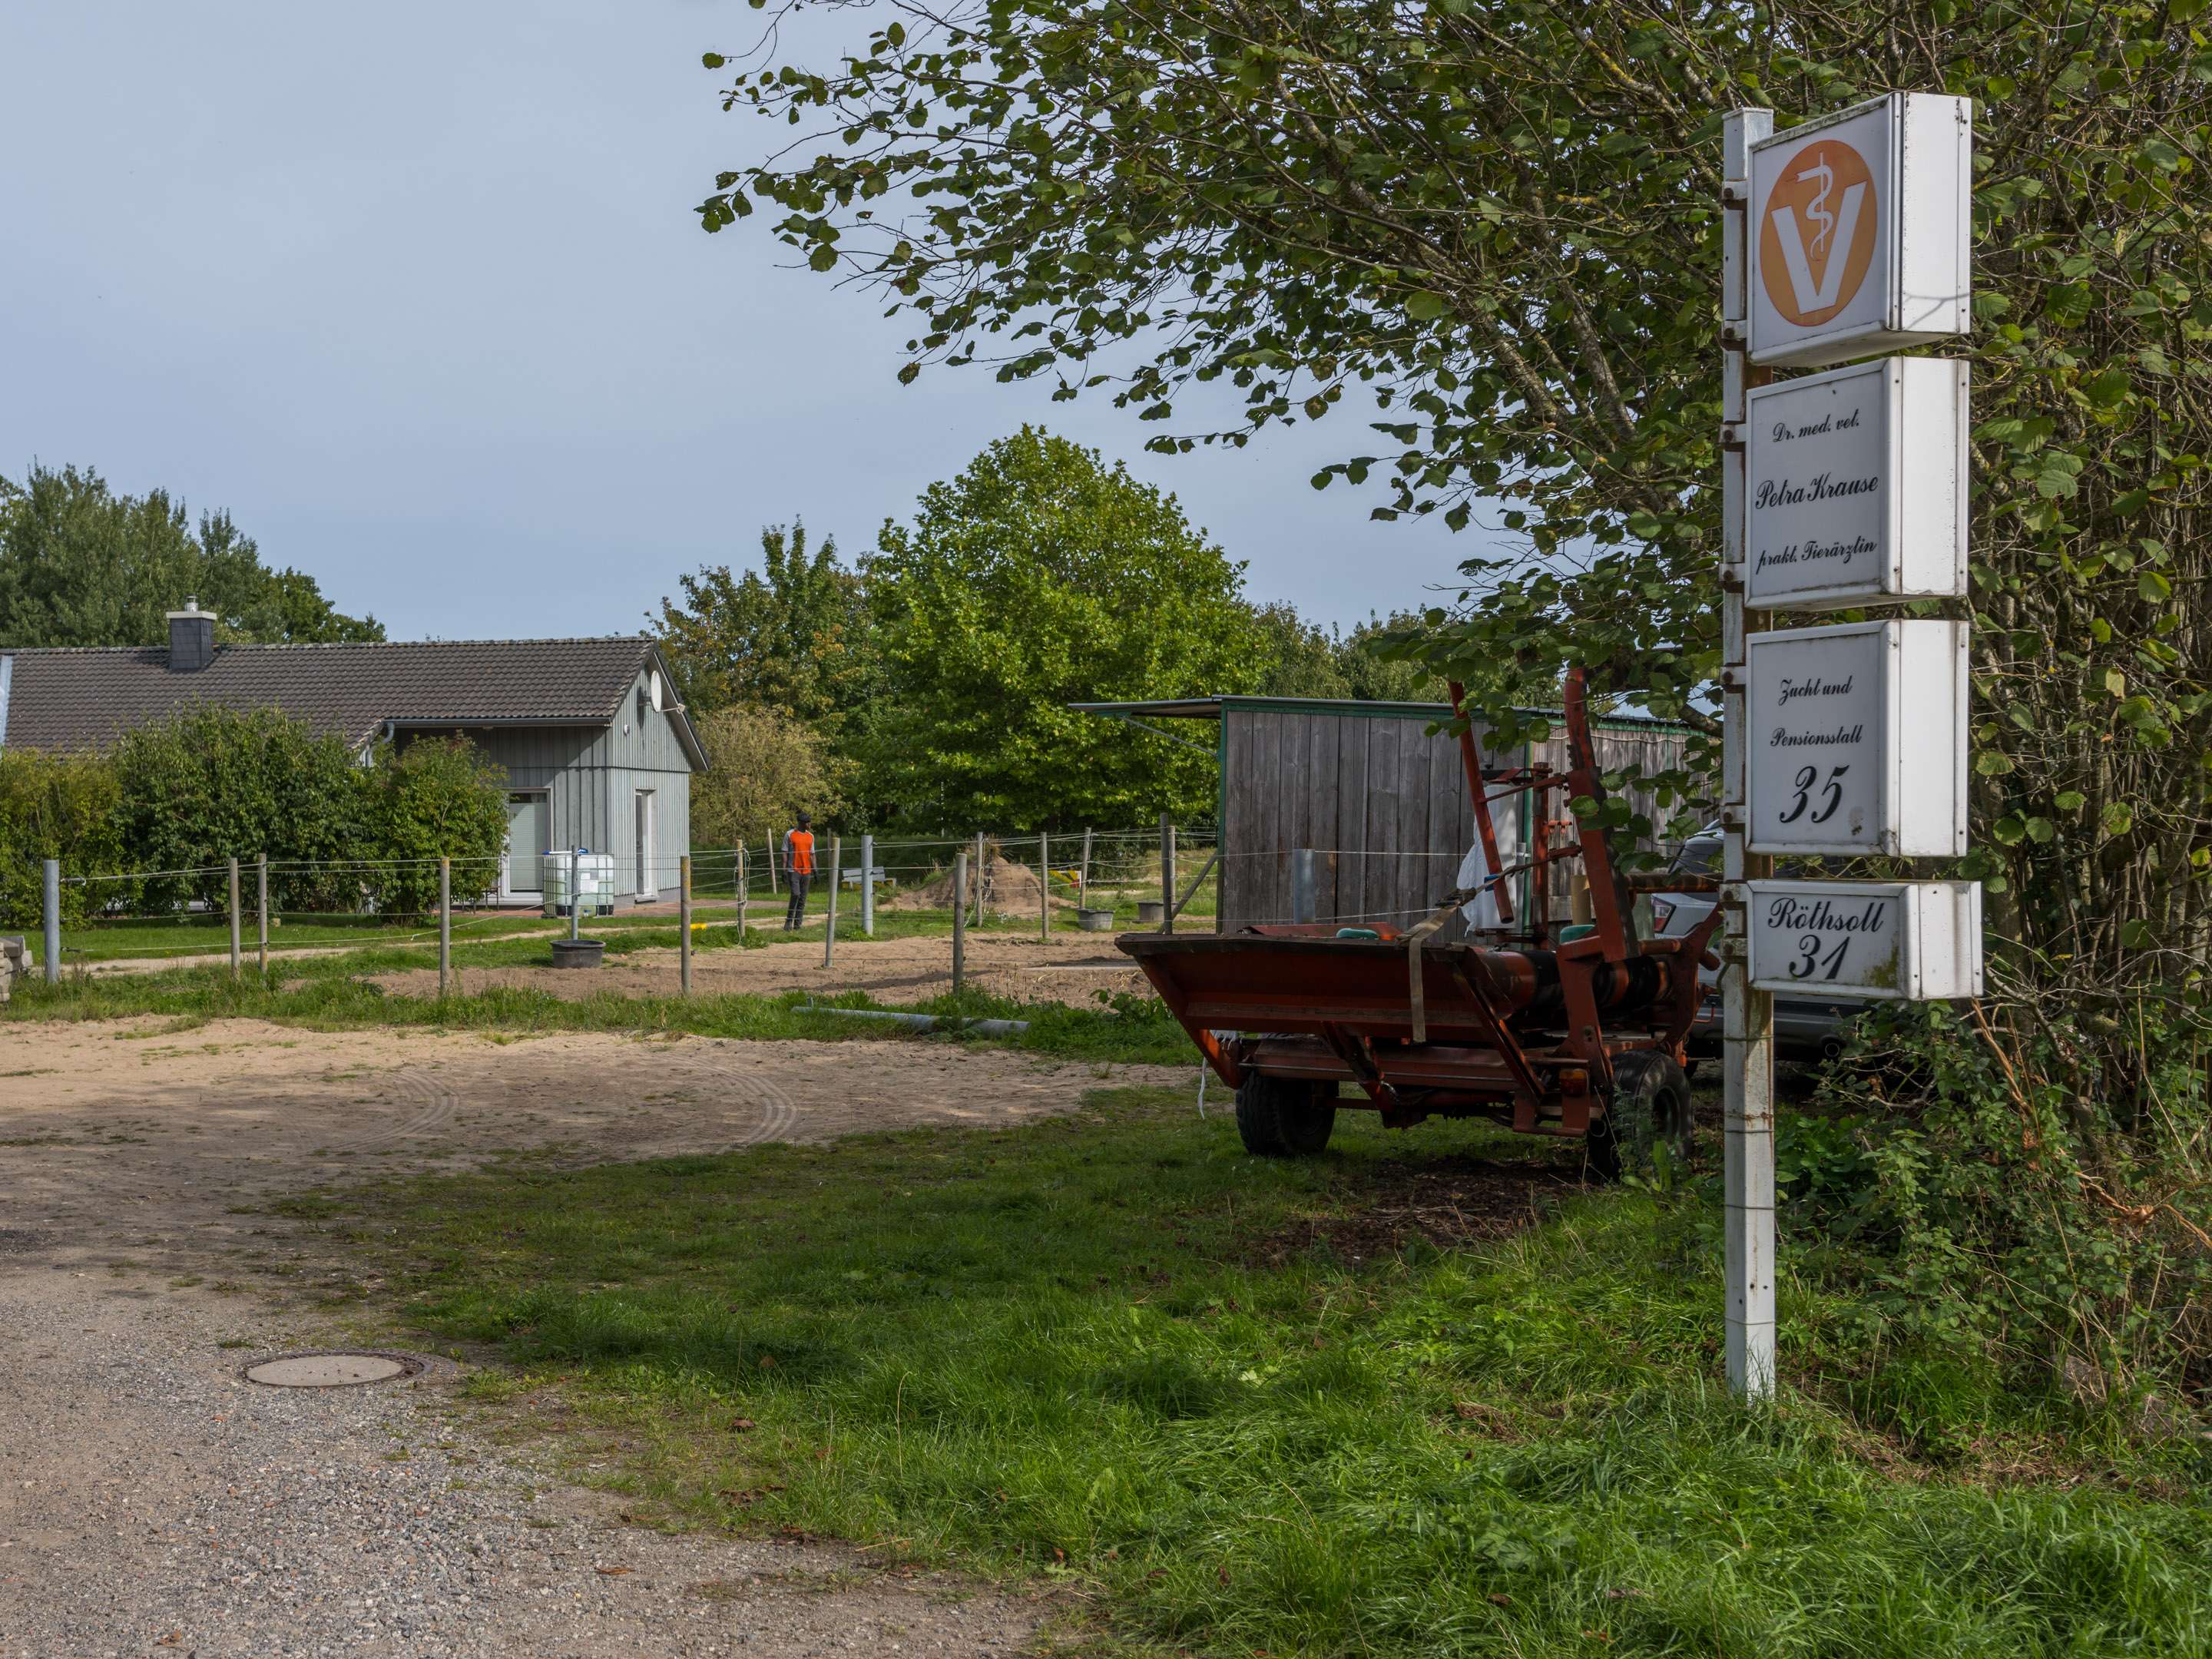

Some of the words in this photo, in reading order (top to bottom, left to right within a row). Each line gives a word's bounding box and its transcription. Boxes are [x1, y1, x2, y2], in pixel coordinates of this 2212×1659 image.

[1773, 422, 1794, 442] Dr.
[1799, 413, 1831, 438] med.
[1836, 408, 1859, 429] vet.
[1755, 479, 1806, 509] Petra
[1807, 472, 1879, 502] Krause
[1756, 545, 1797, 575] prakt.
[1801, 535, 1877, 564] Tierärztin
[1778, 677, 1821, 706] Zucht
[1822, 675, 1853, 695] und
[1770, 724, 1863, 747] Pensionsstall
[1779, 765, 1849, 823] 35
[1768, 897, 1885, 932] Röthsoll
[1789, 934, 1850, 980] 31
